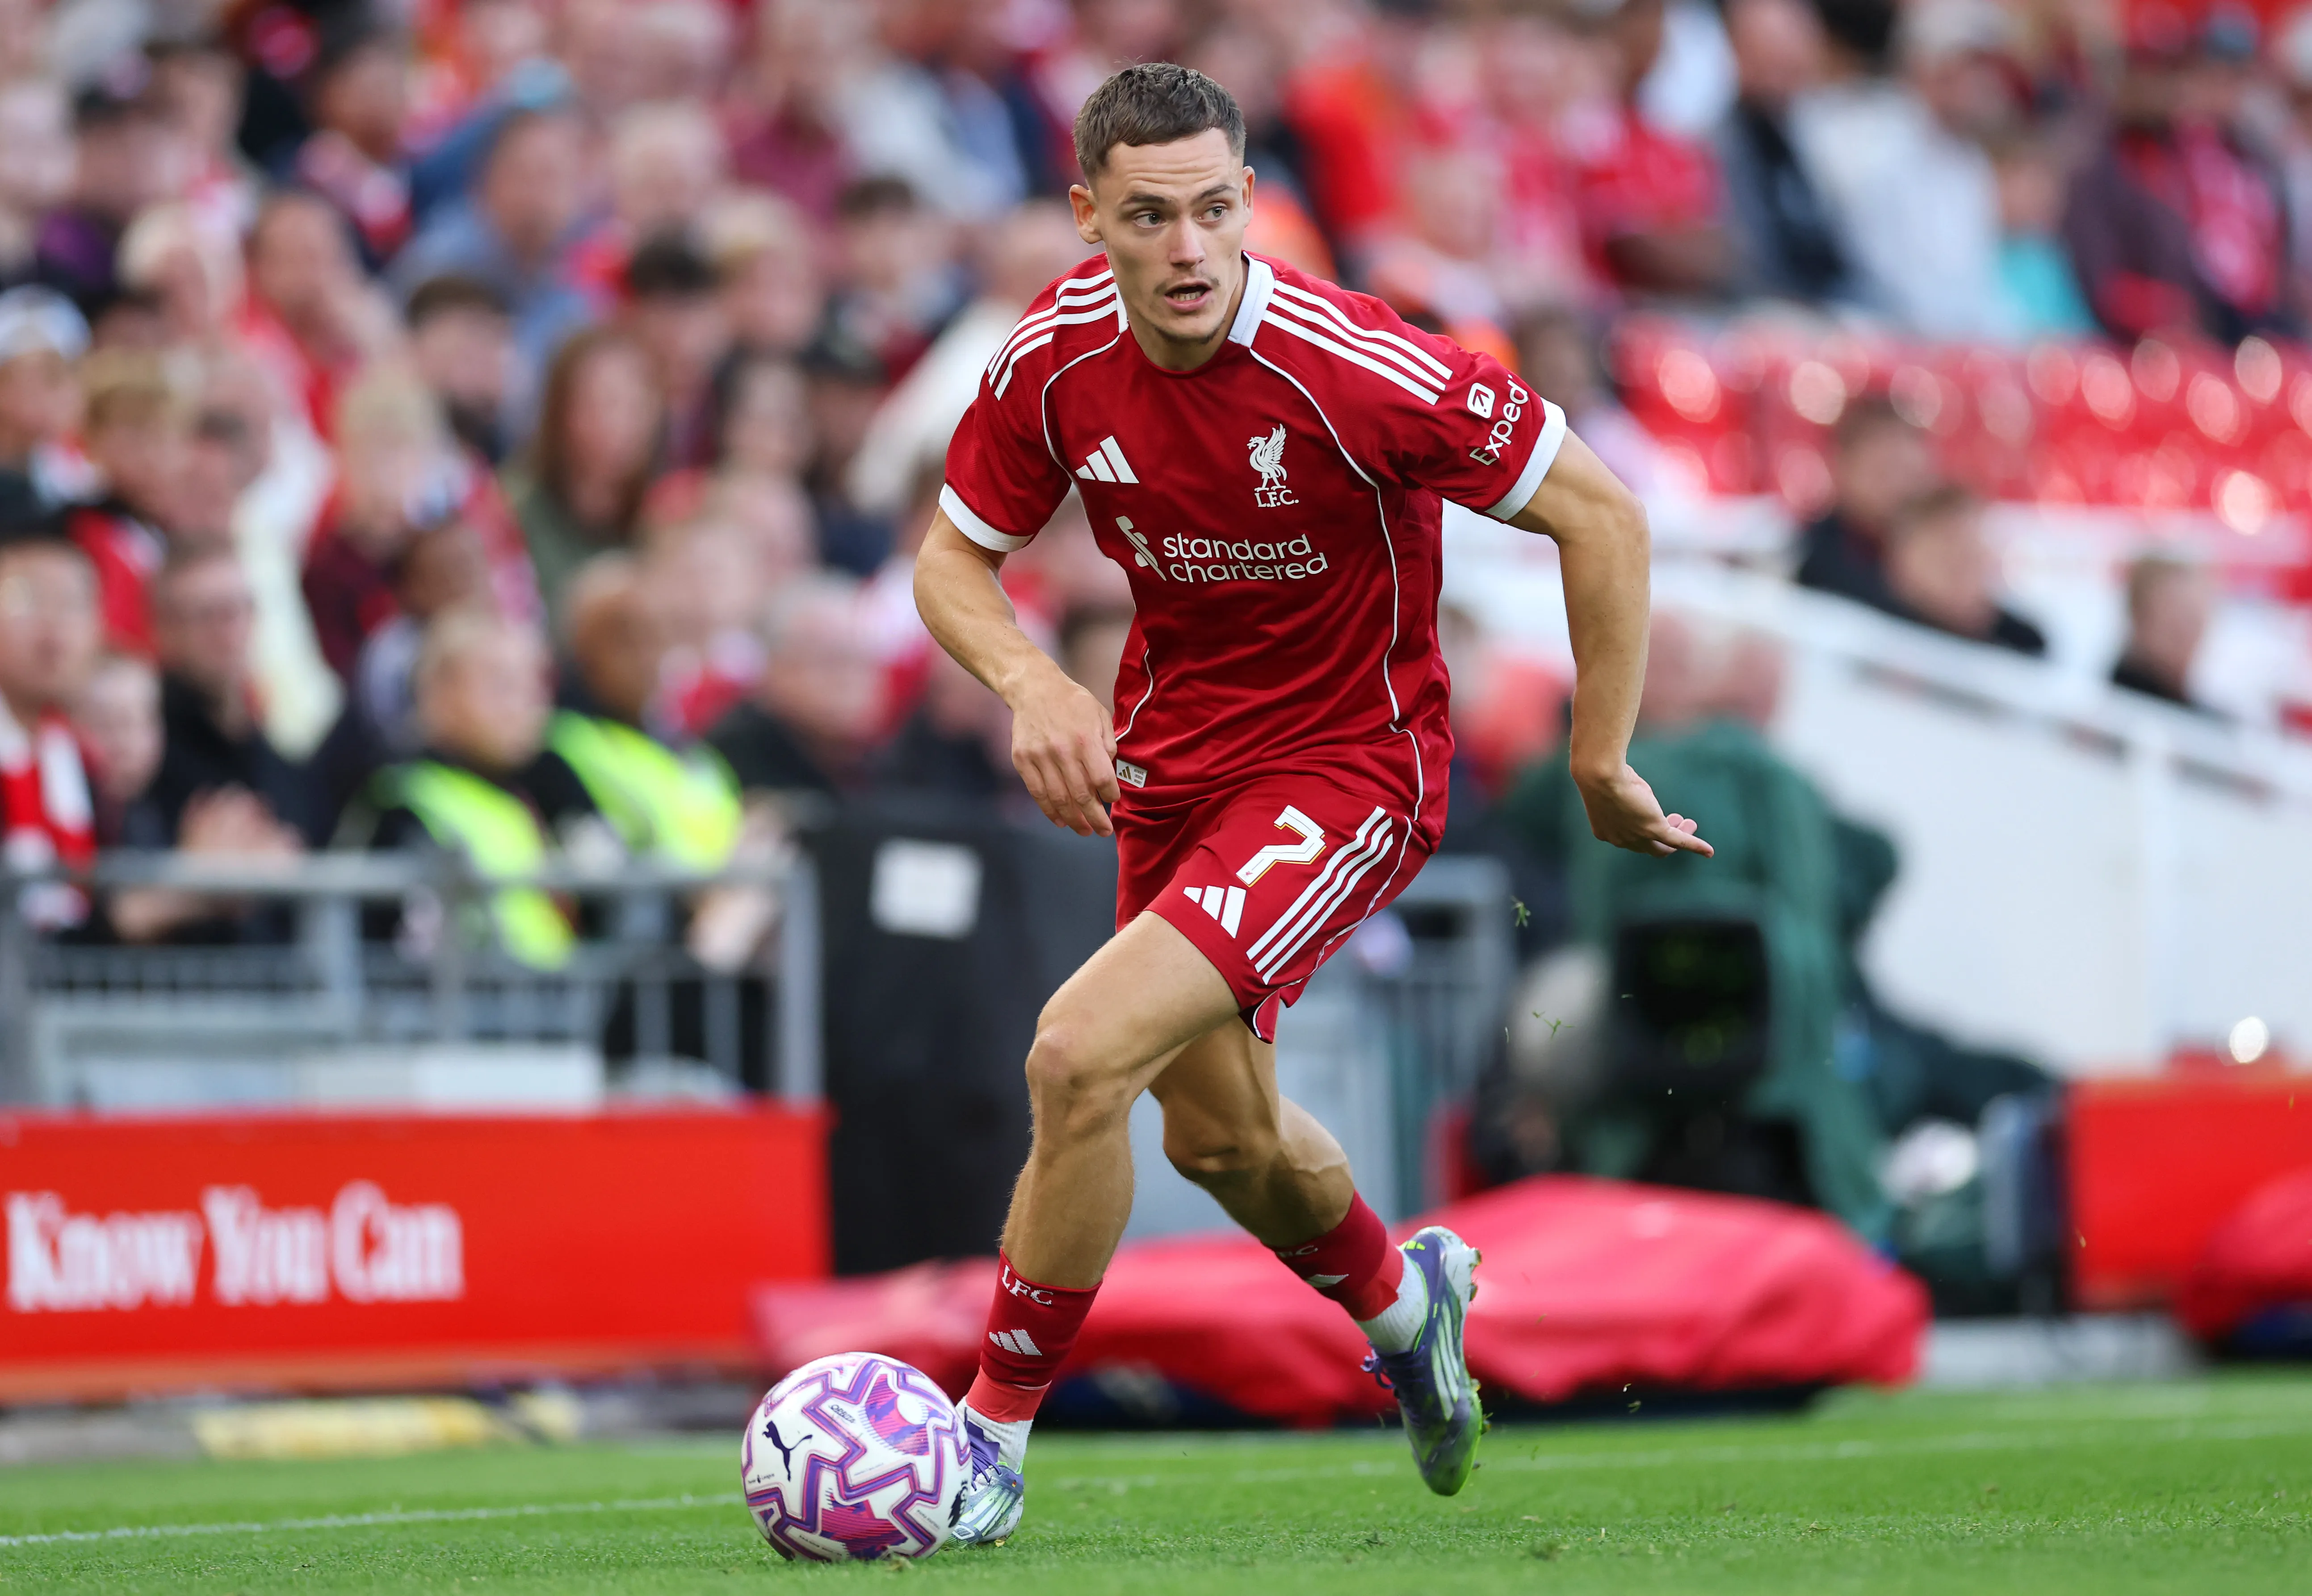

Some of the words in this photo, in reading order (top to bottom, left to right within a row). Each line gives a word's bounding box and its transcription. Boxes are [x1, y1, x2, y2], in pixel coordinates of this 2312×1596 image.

[1469, 374, 1529, 465] Exped
[1254, 489, 1299, 508] L.F.C.
[1163, 532, 1312, 561] standard
[1169, 552, 1329, 583] chartered
[1236, 804, 1327, 888] 7
[5, 1189, 204, 1313] Know
[201, 1184, 330, 1307] You
[331, 1178, 466, 1304] Can
[1002, 1265, 1053, 1305] LFC
